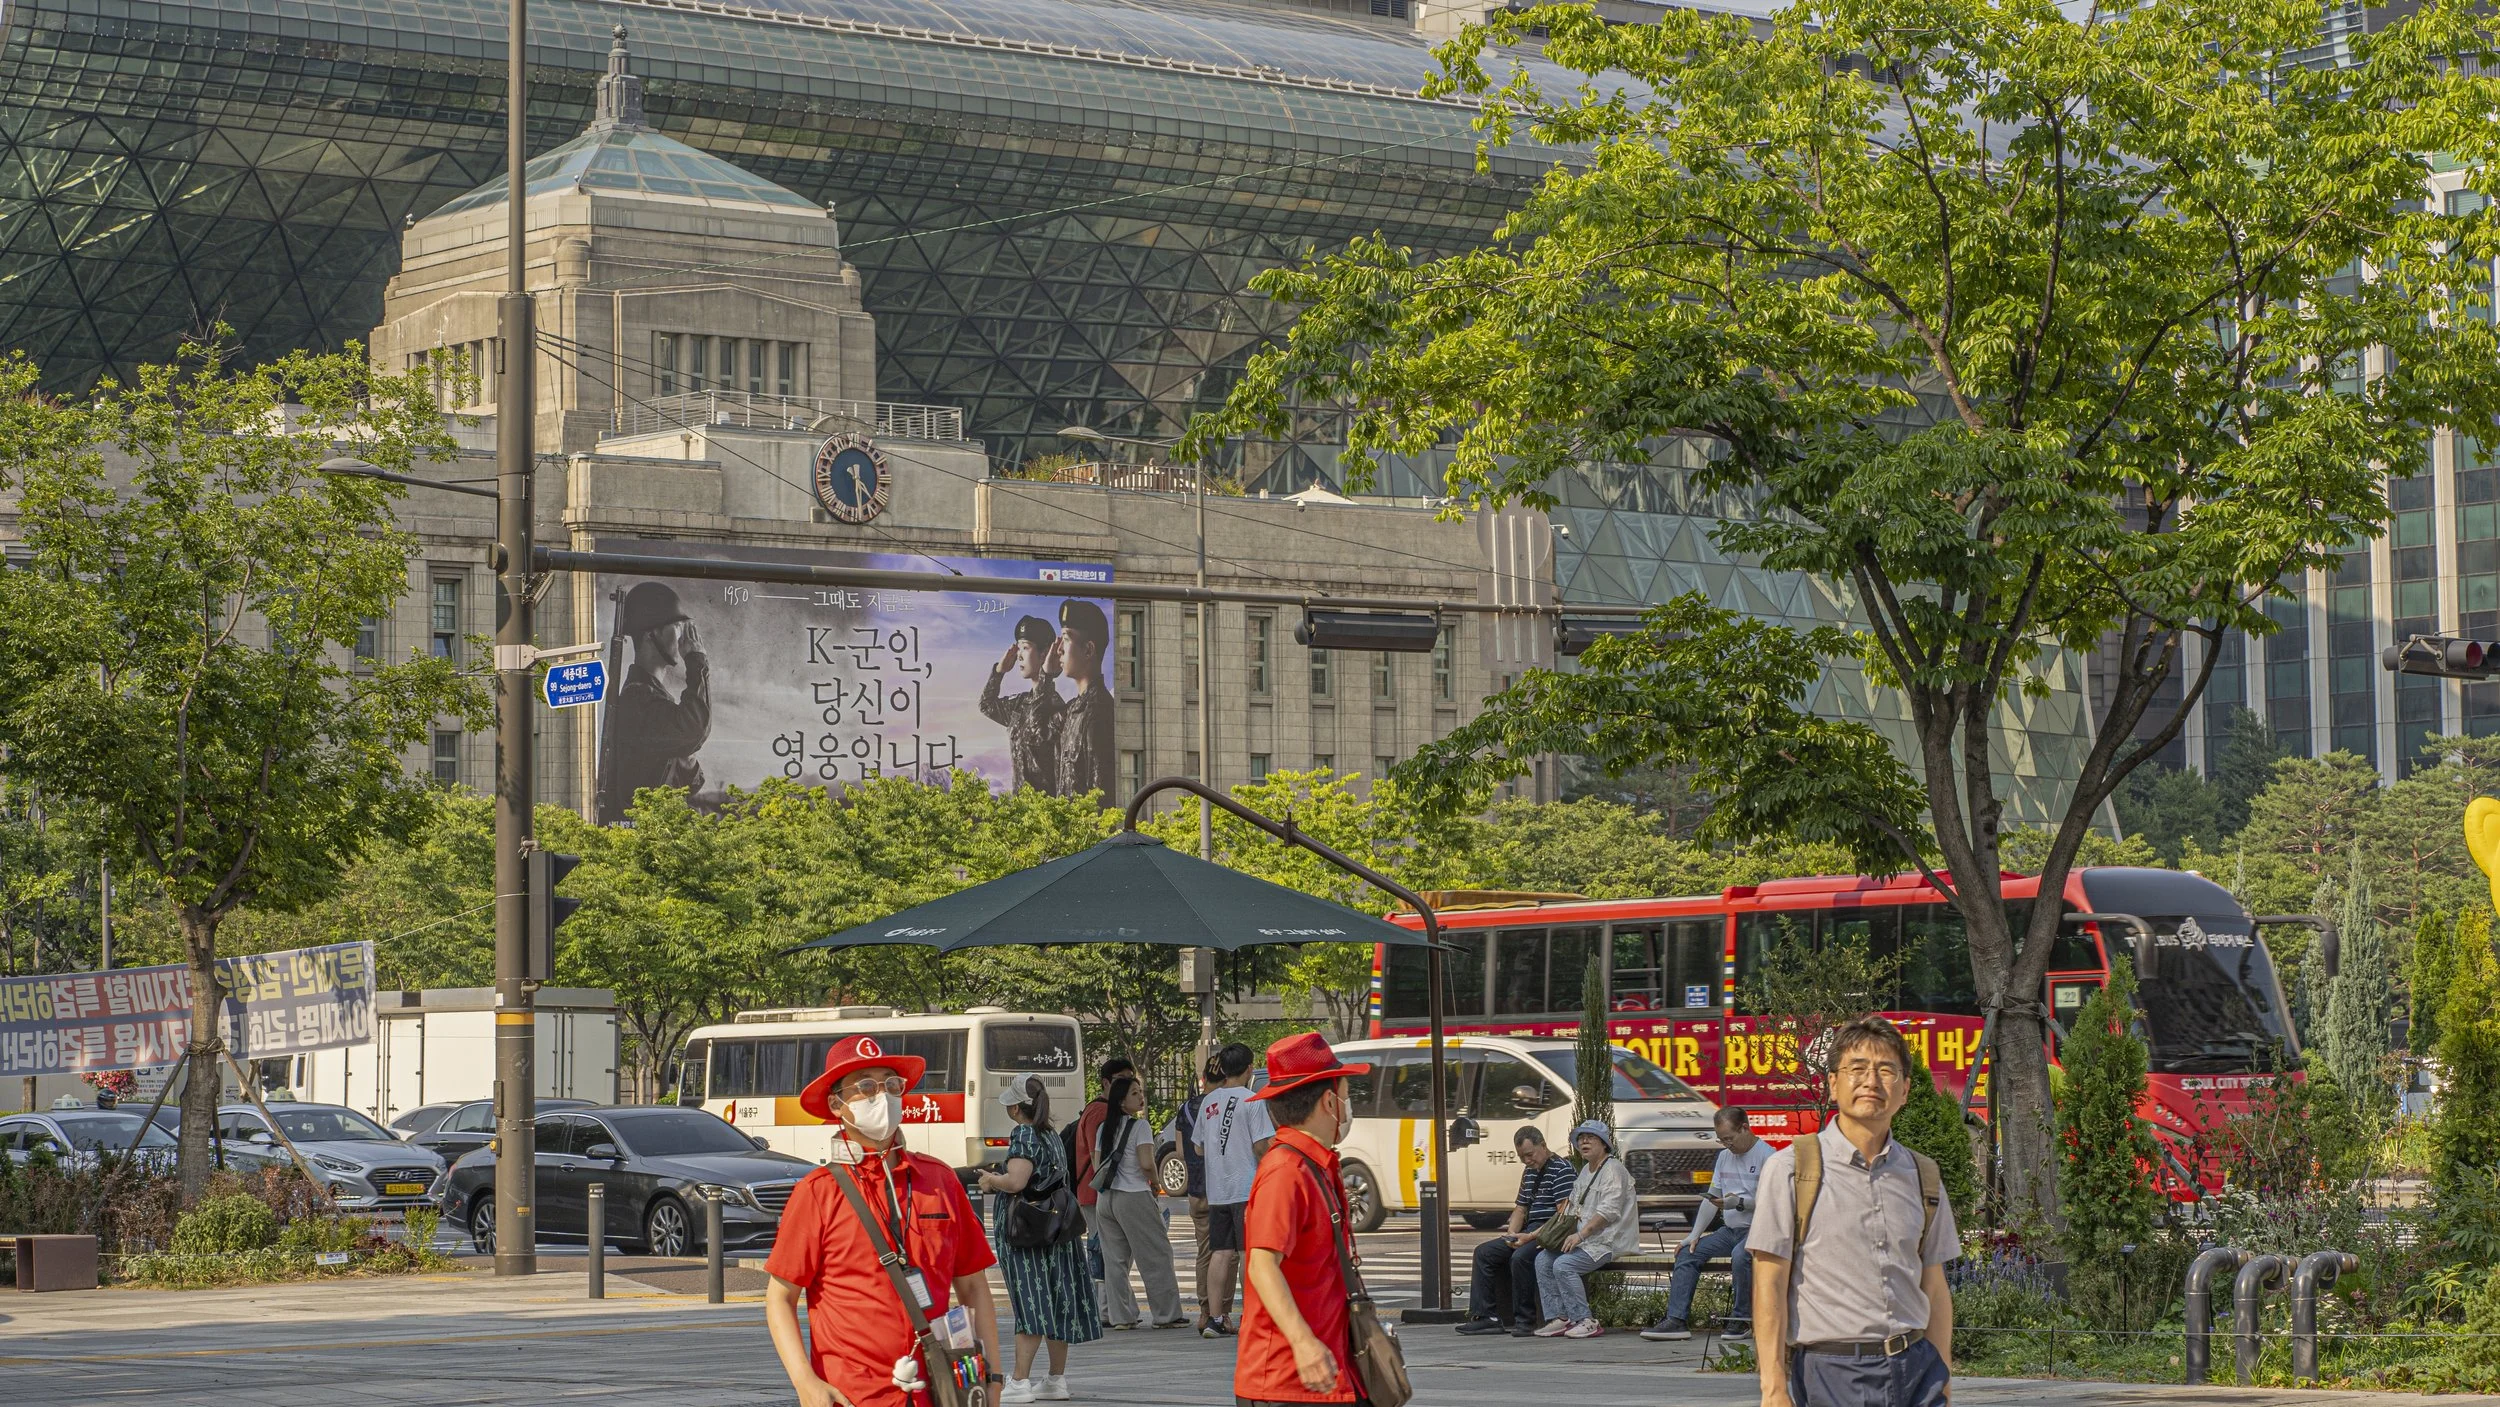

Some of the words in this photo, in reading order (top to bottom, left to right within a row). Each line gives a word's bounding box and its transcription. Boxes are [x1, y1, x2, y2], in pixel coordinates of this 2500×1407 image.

[1062, 570, 1097, 581] 호국보훈의
[1098, 571, 1106, 581] 달
[724, 586, 749, 605] 1950
[813, 590, 861, 612] 그때도
[867, 592, 915, 614] 지금도
[975, 597, 1010, 618] 2024
[806, 626, 932, 679] K-군인,
[562, 667, 588, 680] 세종대로
[550, 682, 557, 691] 99
[560, 682, 592, 693] Sejong-daero
[594, 676, 601, 685] 95
[811, 677, 920, 729] 당신이
[772, 730, 963, 781] 영웅입니다
[1724, 1034, 1800, 1076] BUS
[1937, 1028, 1990, 1069] 버스
[2215, 1077, 2239, 1089] CITY
[739, 1107, 758, 1118] 서울중구
[1767, 1115, 1788, 1127] BUS
[1487, 1150, 1518, 1166] 카카오
